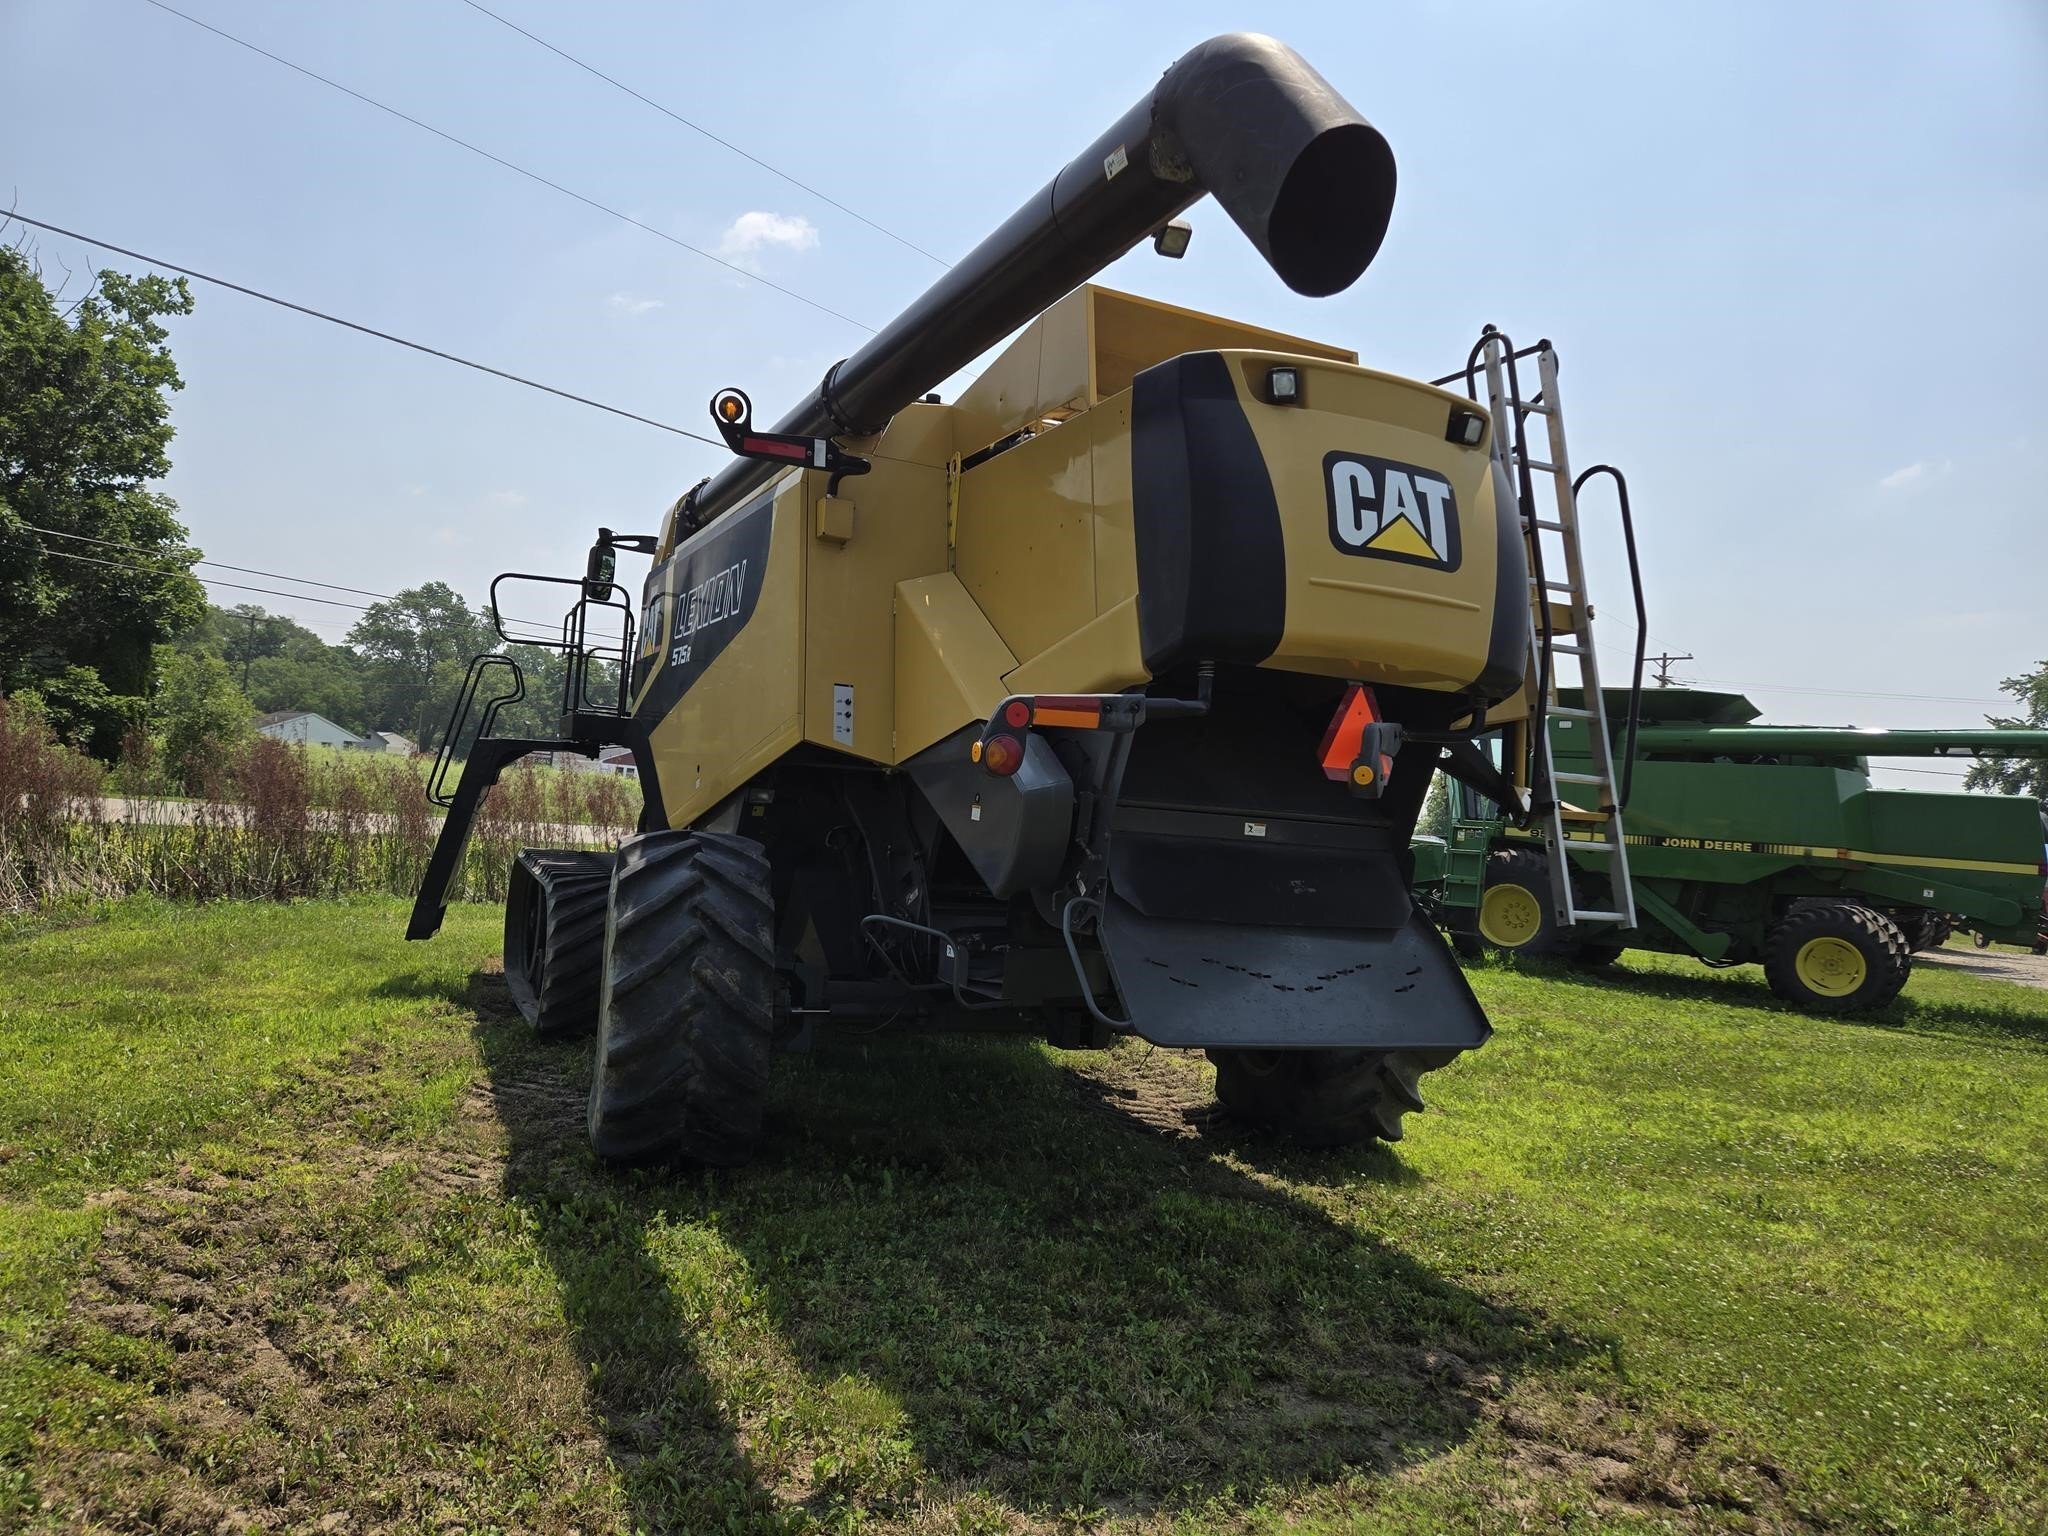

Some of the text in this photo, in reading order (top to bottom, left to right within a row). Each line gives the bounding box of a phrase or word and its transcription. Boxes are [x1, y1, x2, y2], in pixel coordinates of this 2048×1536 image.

[1331, 460, 1450, 562] CAT
[674, 558, 748, 640] LEXION
[1662, 838, 1752, 852] JOHN DEERE
